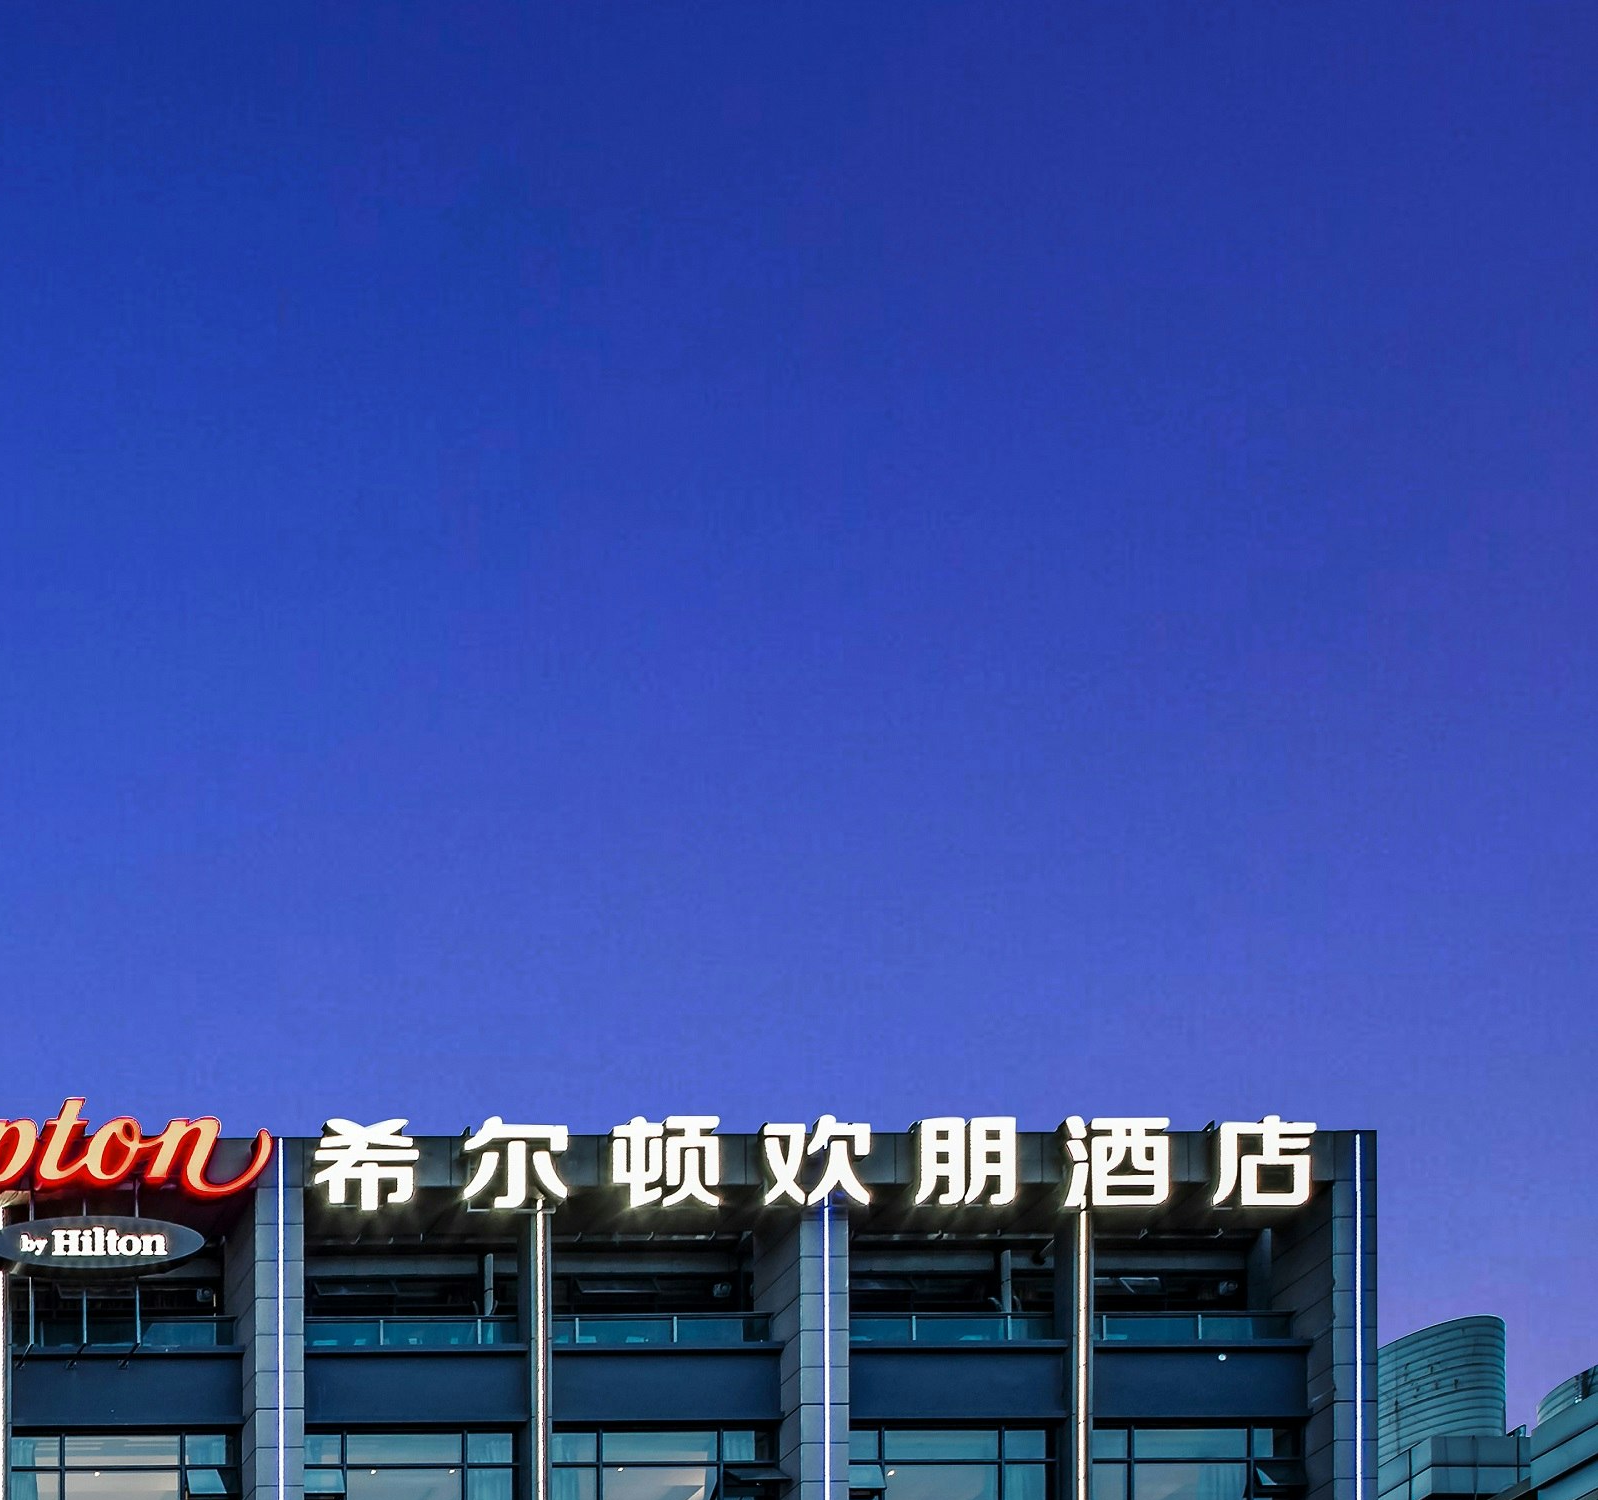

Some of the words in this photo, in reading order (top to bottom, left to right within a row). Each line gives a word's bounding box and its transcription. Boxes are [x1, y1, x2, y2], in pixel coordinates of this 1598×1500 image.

[313, 1114, 1320, 1212] 希尔顿欢朋酒店
[20, 1233, 49, 1257] by
[51, 1226, 169, 1257] Hilton
